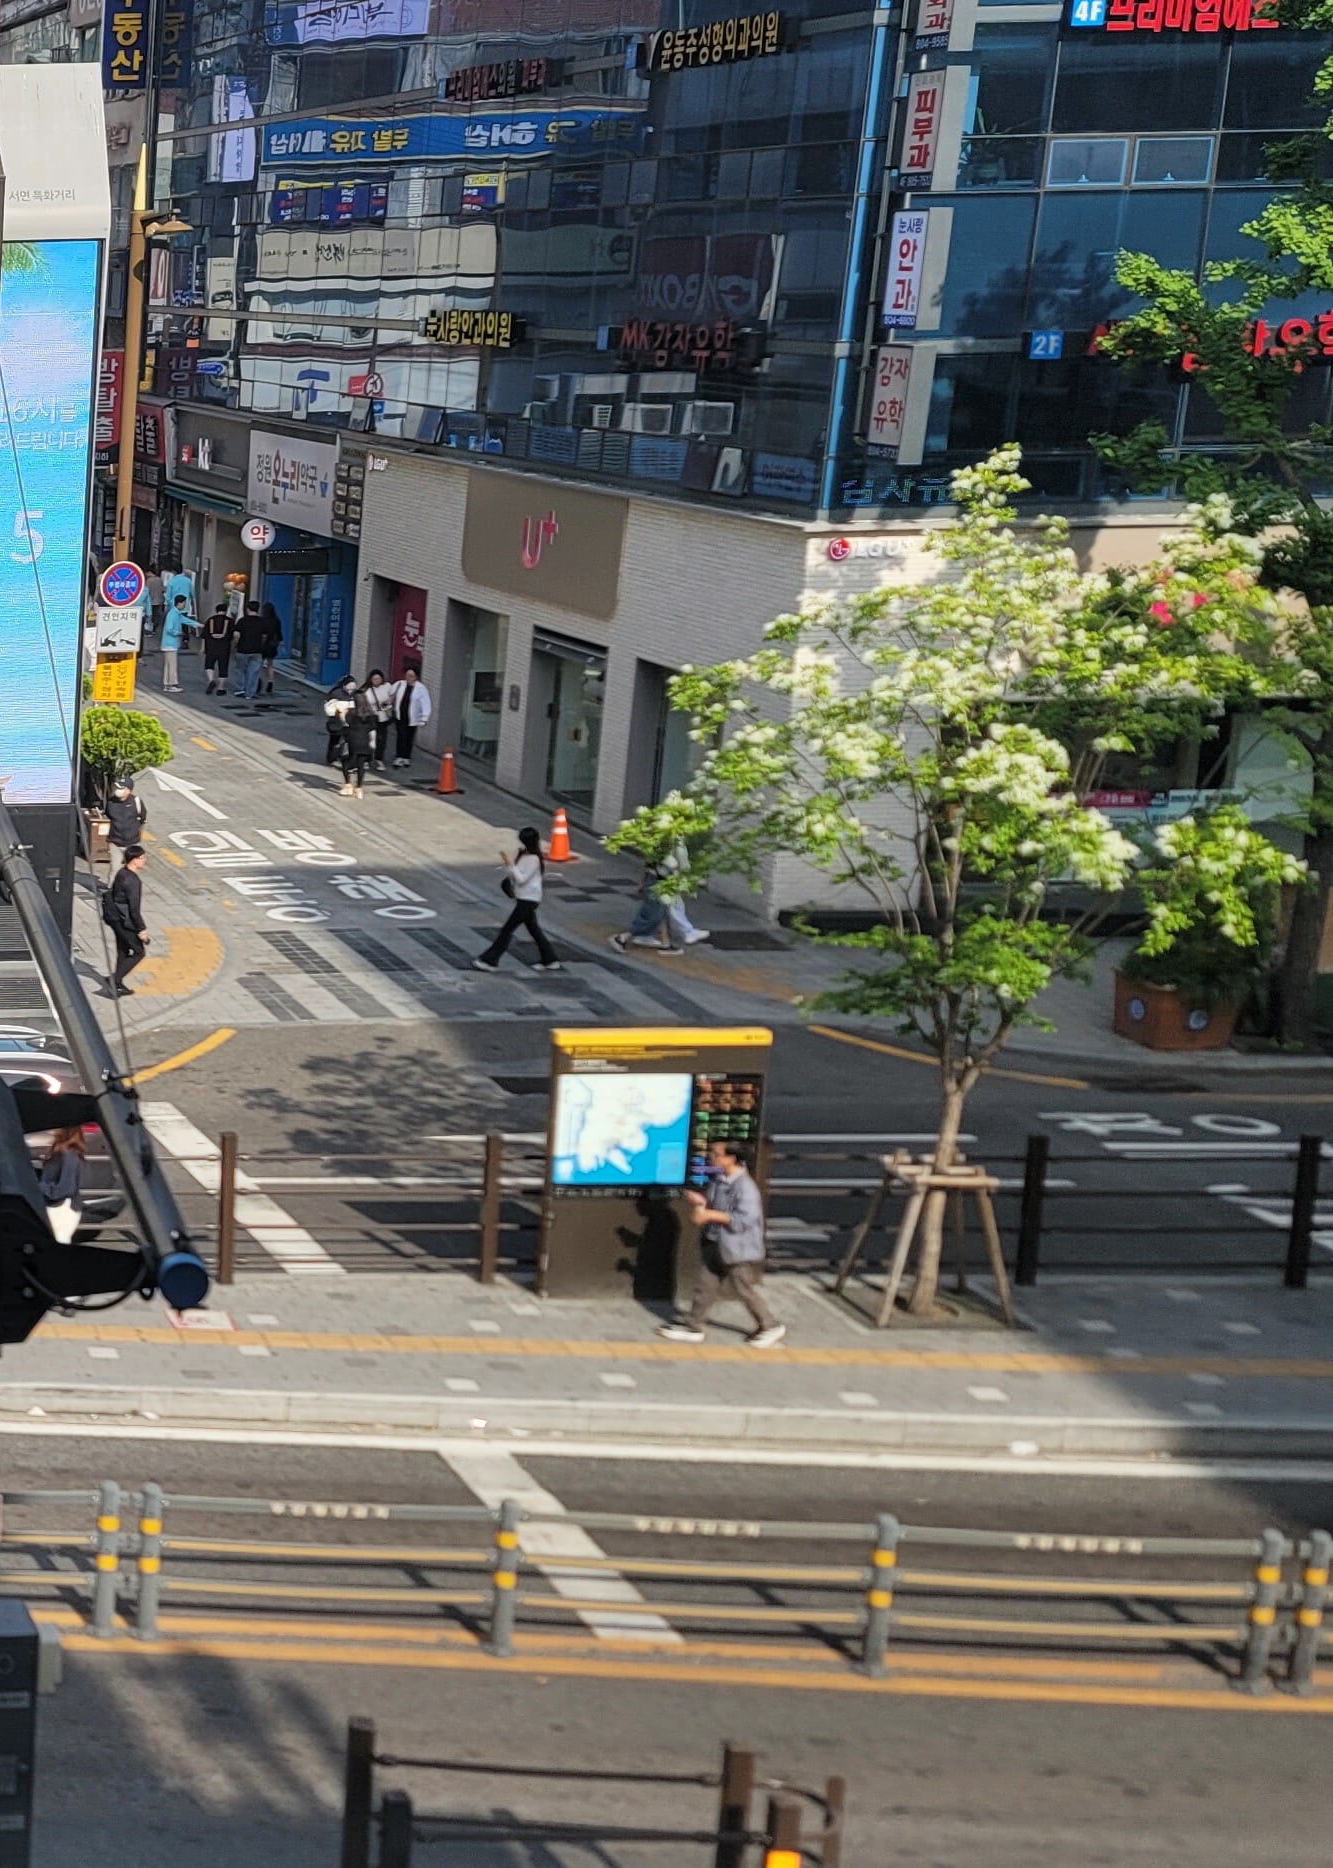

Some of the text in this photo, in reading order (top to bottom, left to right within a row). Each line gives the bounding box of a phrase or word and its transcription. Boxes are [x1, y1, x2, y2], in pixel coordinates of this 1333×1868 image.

[110, 0, 144, 81] 동산
[907, 88, 937, 168] 피부과
[9, 190, 31, 201] 서면
[898, 217, 923, 233] 눈사랑
[892, 238, 917, 311] 안과
[1034, 337, 1062, 354] 2F
[873, 400, 904, 433] 유학
[11, 510, 45, 563] 5
[250, 525, 270, 545] 약
[102, 612, 137, 622] 견인지역
